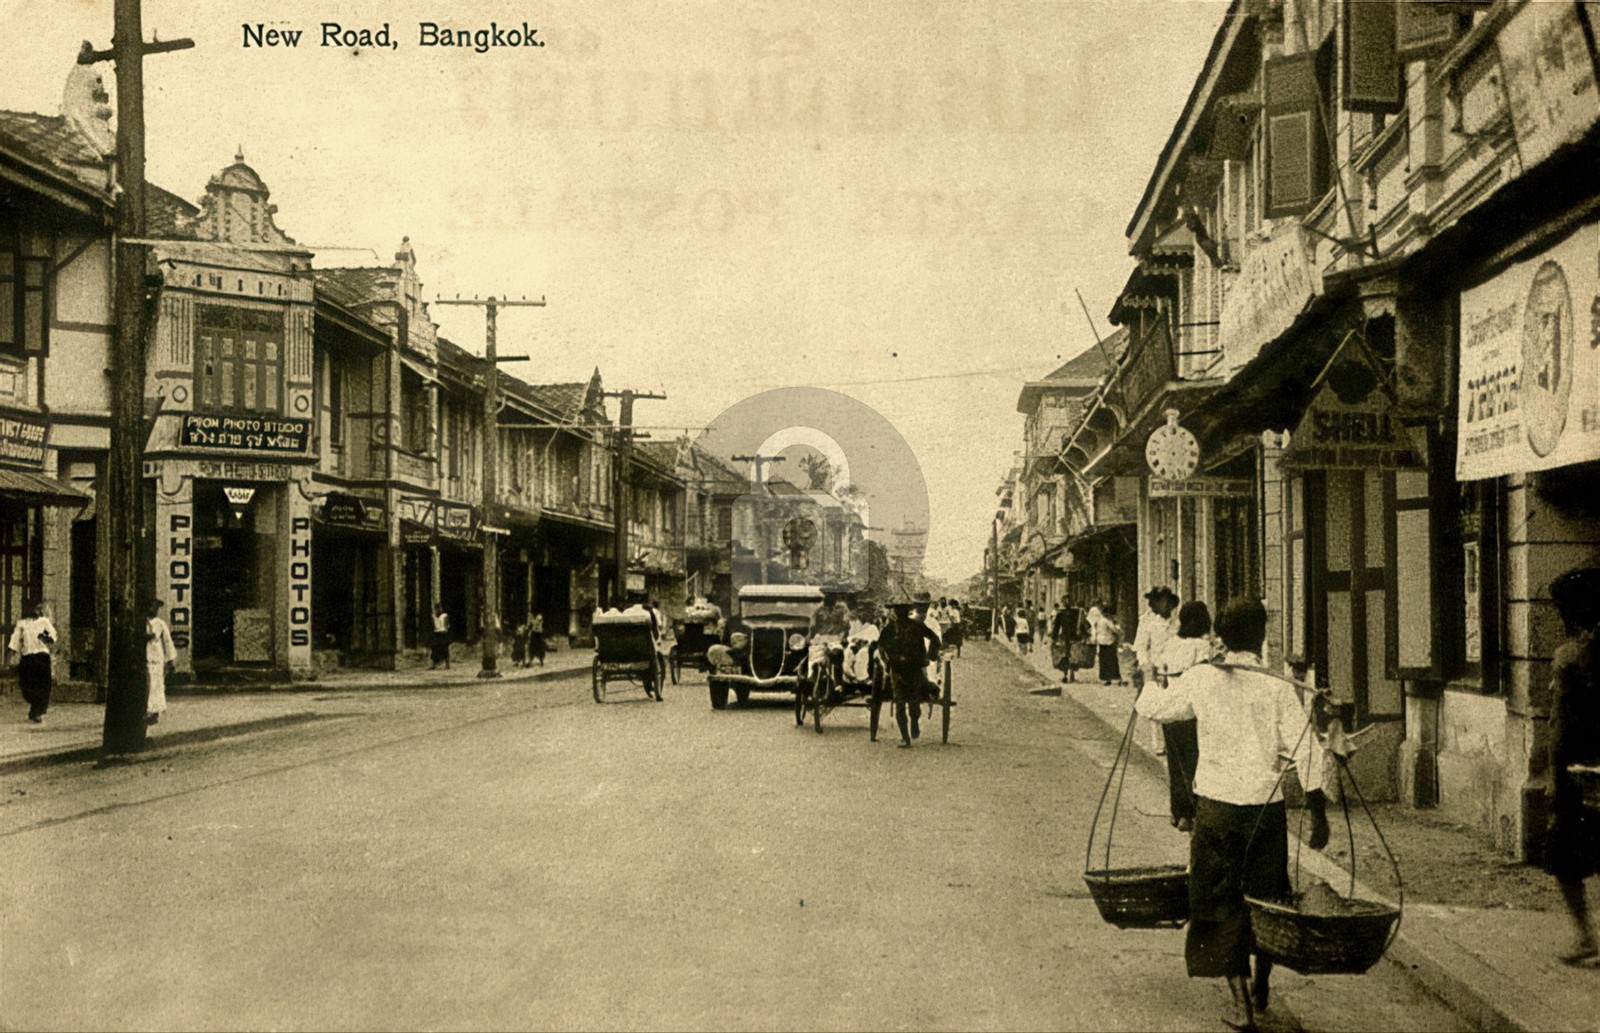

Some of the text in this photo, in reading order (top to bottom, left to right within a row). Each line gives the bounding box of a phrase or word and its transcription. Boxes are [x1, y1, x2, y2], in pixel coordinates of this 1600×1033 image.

[223, 418, 260, 431] PHOTO
[170, 514, 191, 647] PHOTOS
[291, 517, 310, 646] PHOTOS
